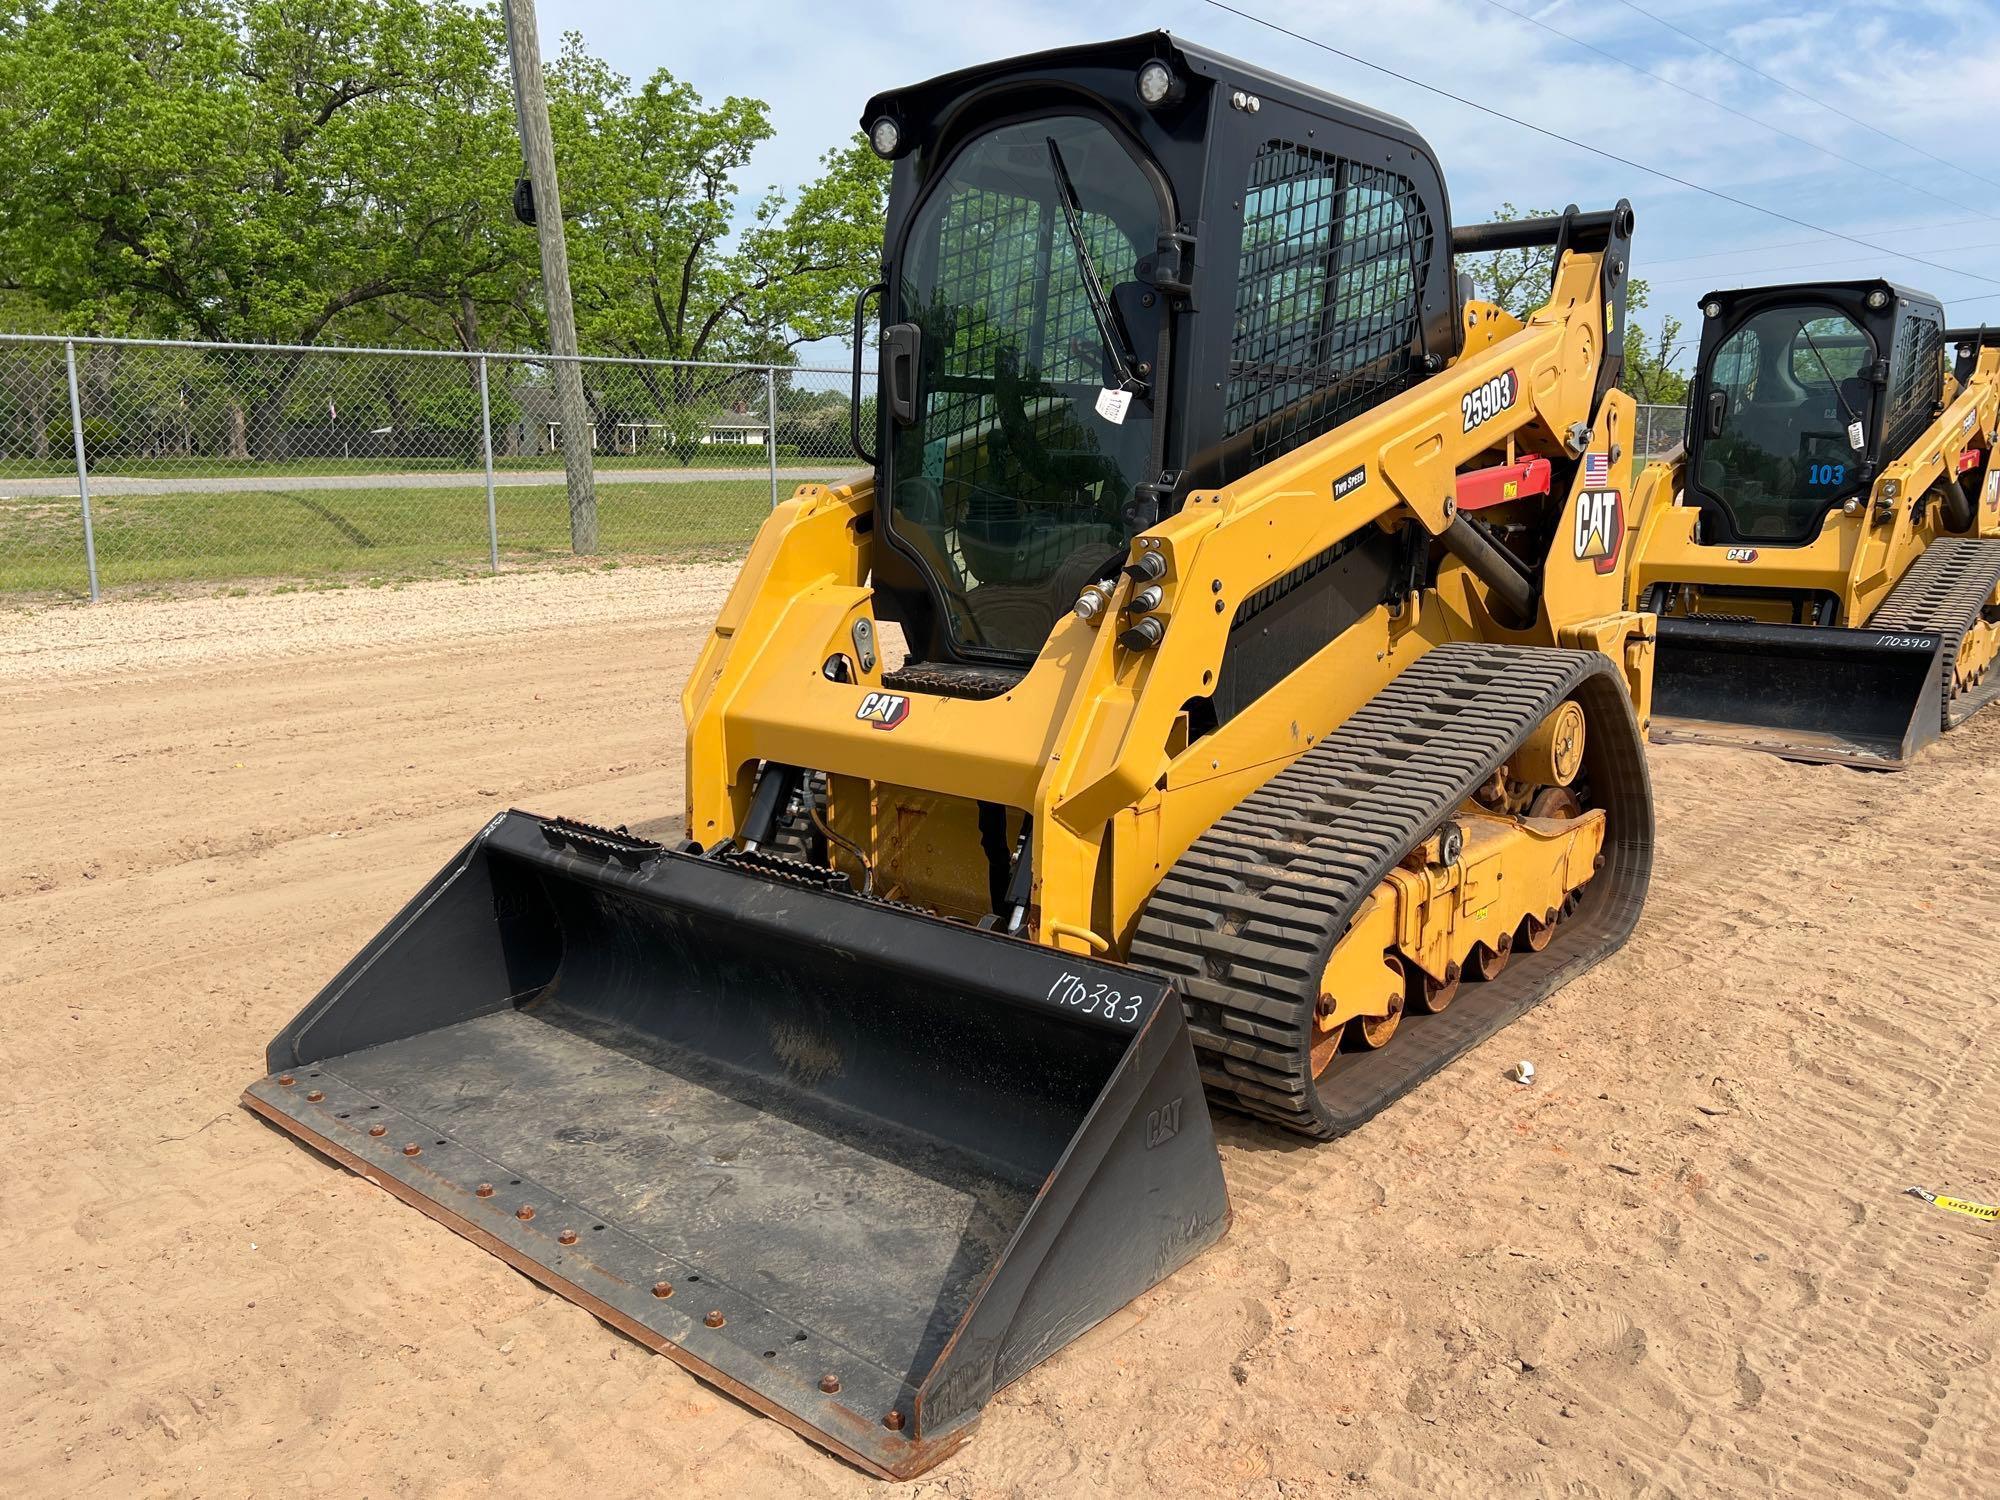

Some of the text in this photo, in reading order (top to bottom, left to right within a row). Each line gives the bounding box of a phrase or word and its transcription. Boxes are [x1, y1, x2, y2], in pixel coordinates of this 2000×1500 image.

[1462, 372, 1511, 432] 259D3
[1808, 464, 1845, 485] 103
[1574, 492, 1616, 558] CAT
[1727, 549, 1753, 561] CAT
[1876, 635, 1931, 648] 170390
[857, 692, 905, 723] CAT
[1046, 971, 1143, 1023] 170383
[1146, 1097, 1183, 1150] CAT
[1948, 1202, 2000, 1217] Milton
